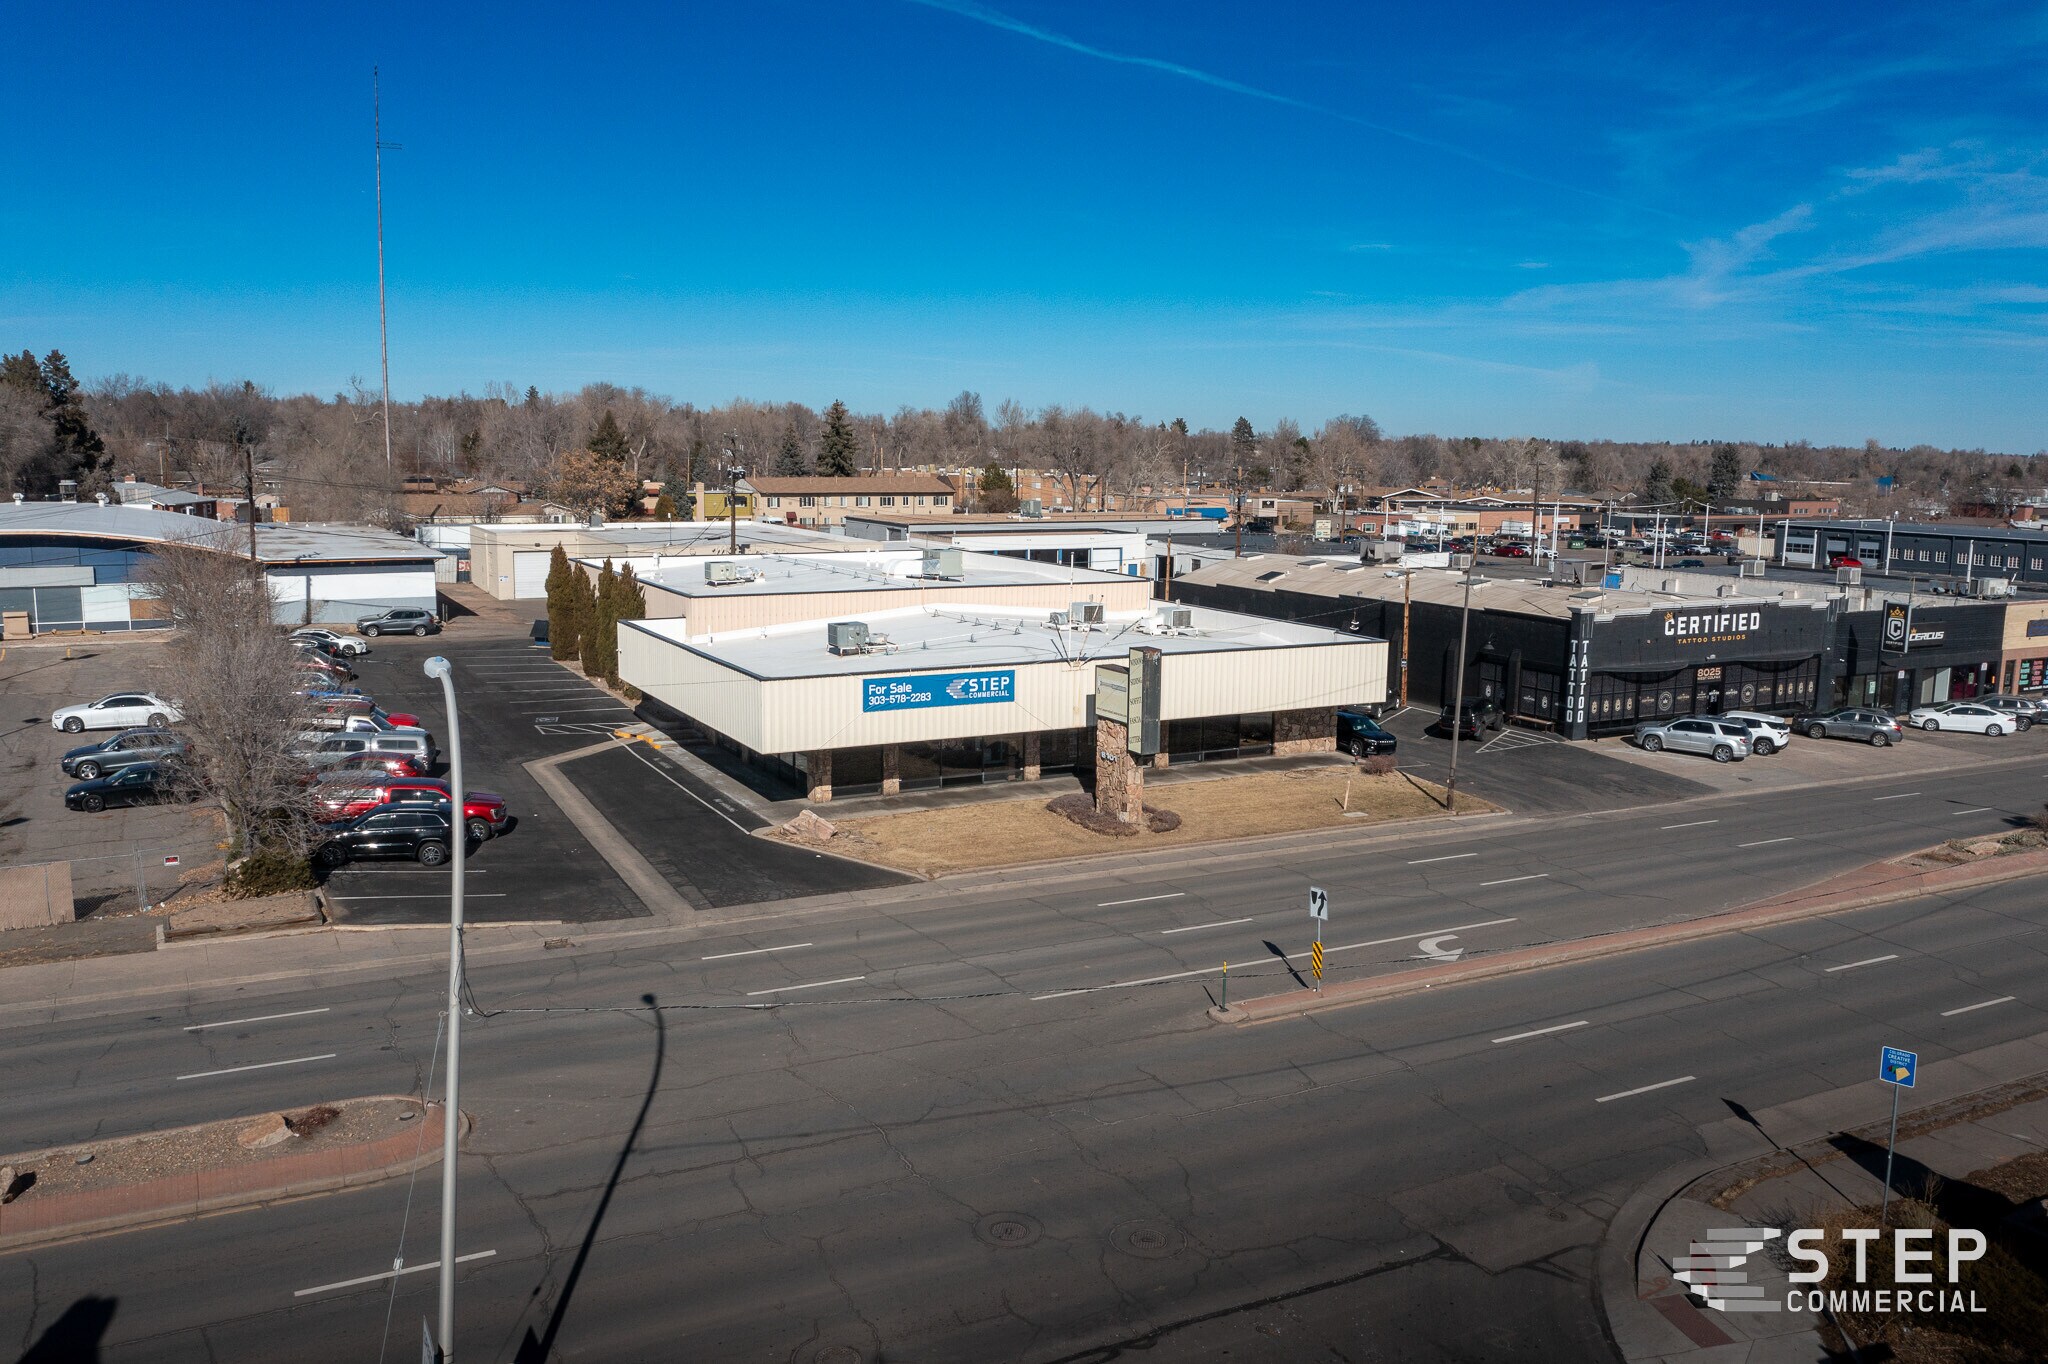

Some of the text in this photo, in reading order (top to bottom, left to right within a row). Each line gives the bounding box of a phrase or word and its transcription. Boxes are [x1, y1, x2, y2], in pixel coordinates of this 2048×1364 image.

[1664, 612, 1760, 636] CERTIFIED
[1677, 634, 1746, 645] TATTOO STUDIOS
[1697, 667, 1721, 677] 8025
[969, 676, 1010, 692] STEP
[1566, 639, 1578, 723] TATTOO
[1577, 640, 1590, 723] TATTOO
[868, 682, 913, 695] For Sale
[969, 690, 1010, 699] COMMERCIAL
[868, 692, 932, 706] 303-578-2283
[1888, 1054, 1910, 1063] CREATIVE
